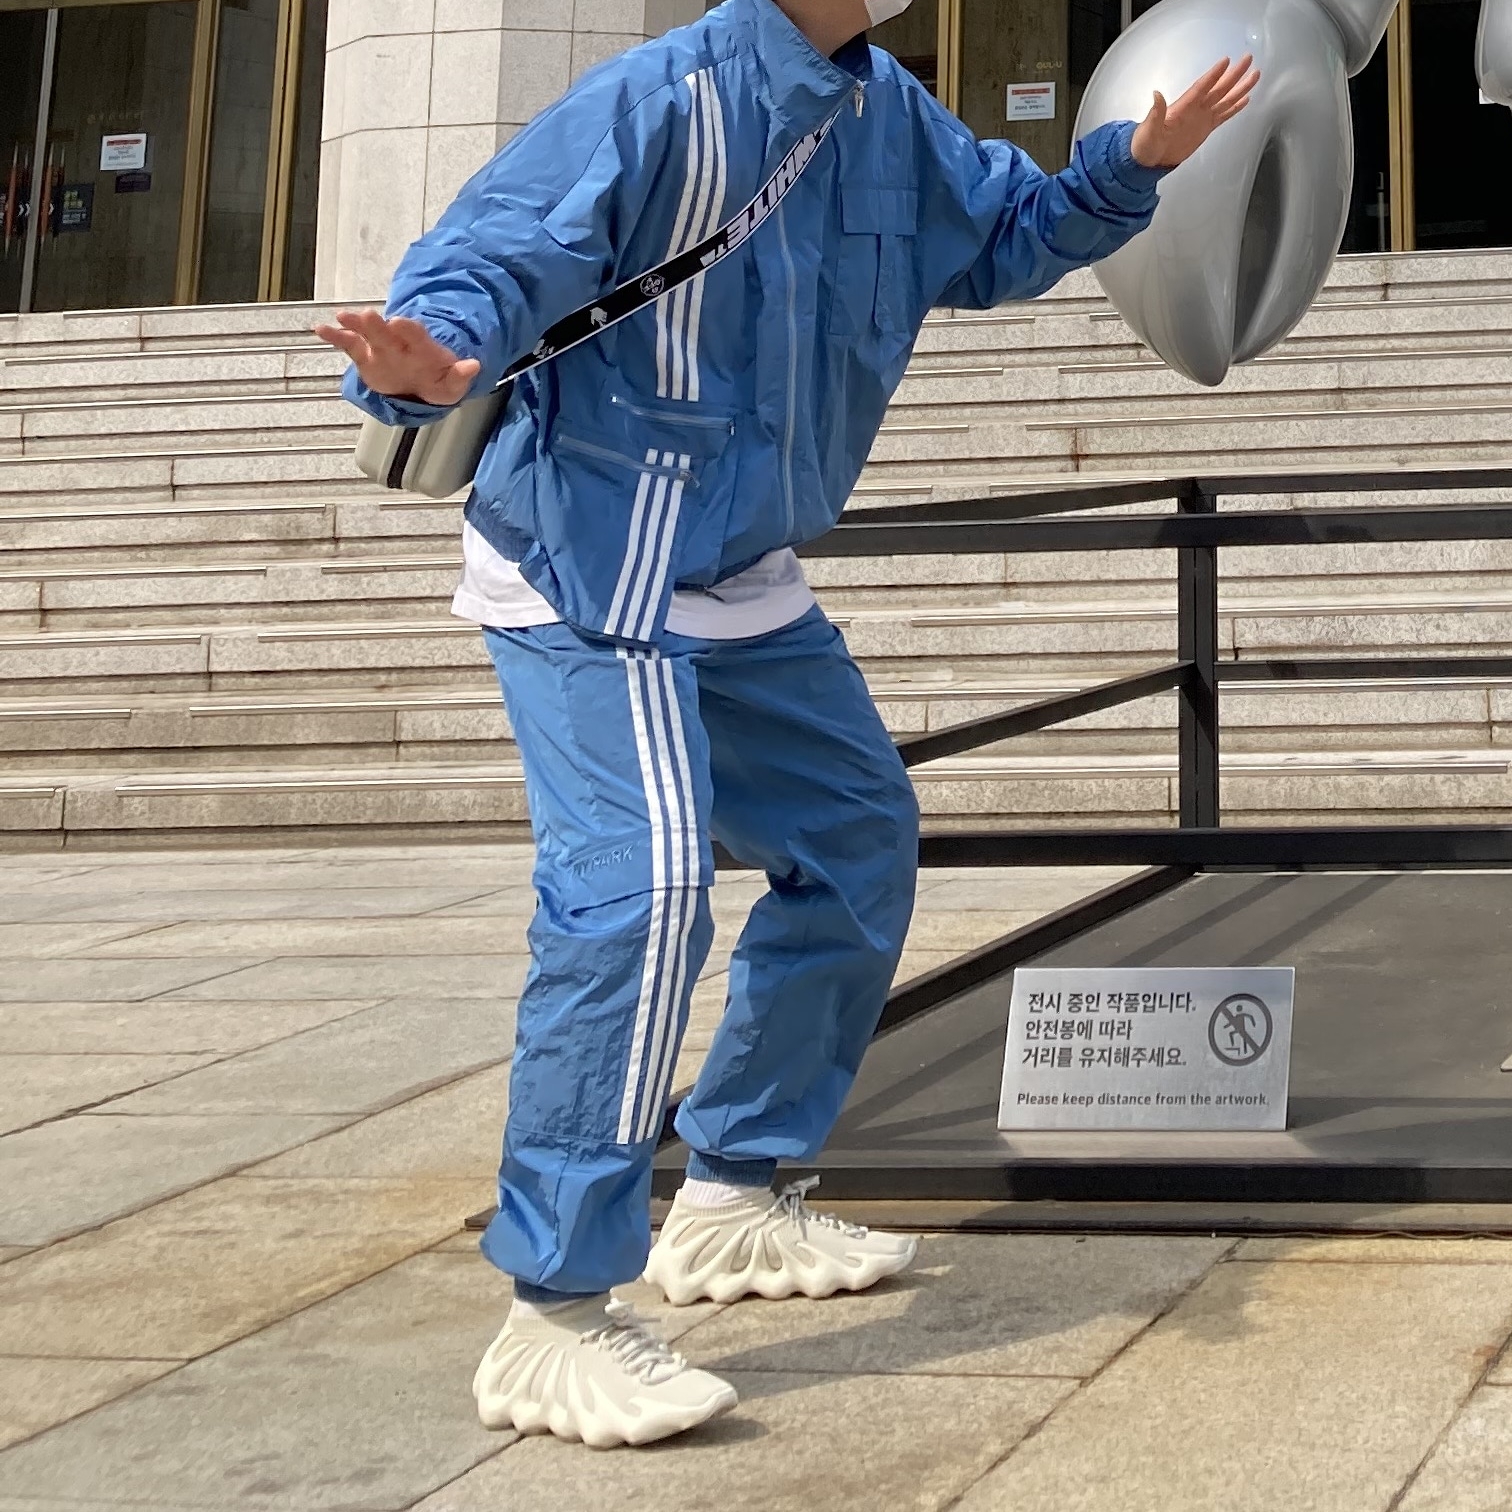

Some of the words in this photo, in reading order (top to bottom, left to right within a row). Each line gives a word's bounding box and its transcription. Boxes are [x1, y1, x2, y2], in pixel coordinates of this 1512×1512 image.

[591, 844, 634, 872] PARK
[1028, 991, 1062, 1013] 전시
[1066, 991, 1101, 1013] 중인
[1106, 991, 1197, 1013] 작품입니다.
[1025, 1019, 1094, 1040] 안전봉에
[1098, 1019, 1133, 1040] 따라
[1022, 1046, 1073, 1068] 거리를
[1078, 1046, 1187, 1068] 유지해주세요.
[1016, 1092, 1059, 1105] Please
[1062, 1092, 1094, 1108] keep
[1097, 1092, 1152, 1106] distance
[1155, 1092, 1187, 1105] from
[1189, 1092, 1212, 1105] the
